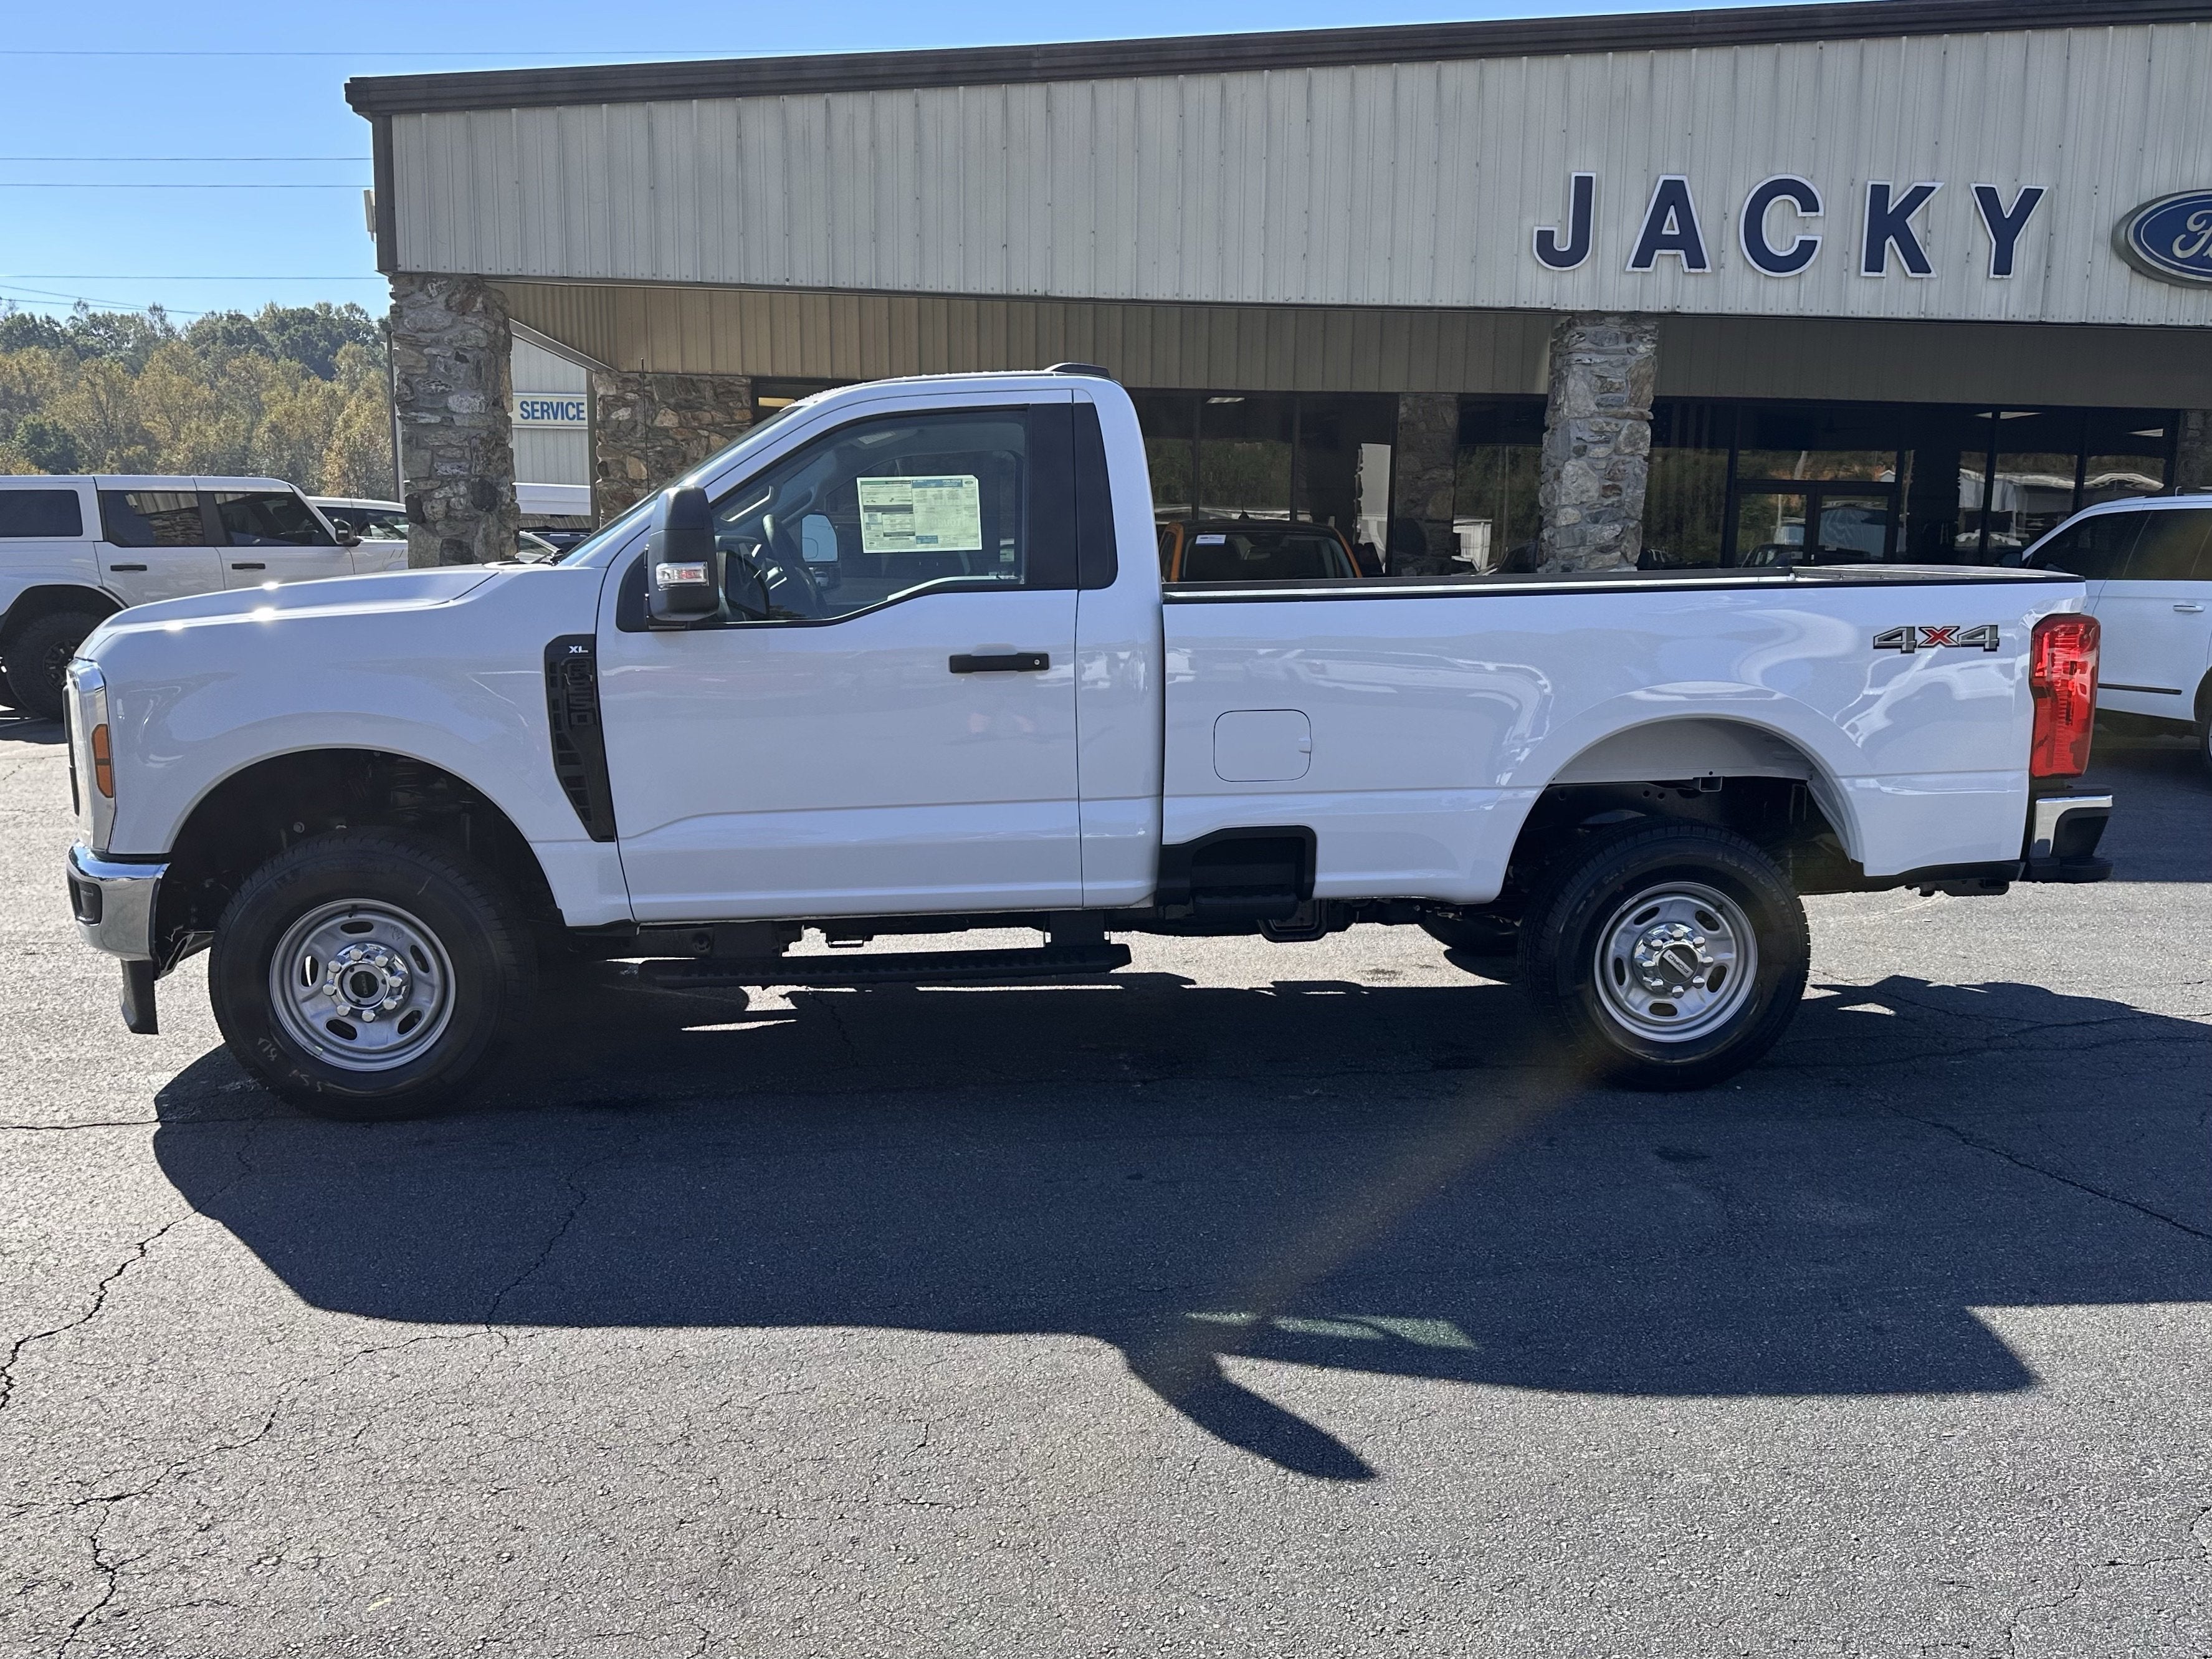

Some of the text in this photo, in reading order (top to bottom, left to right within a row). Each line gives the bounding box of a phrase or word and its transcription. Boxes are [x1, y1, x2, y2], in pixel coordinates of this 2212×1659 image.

[1532, 171, 2049, 279] JACKY
[520, 400, 586, 421] SERVICE
[568, 646, 589, 654] XL
[1667, 954, 1690, 976] FORD
